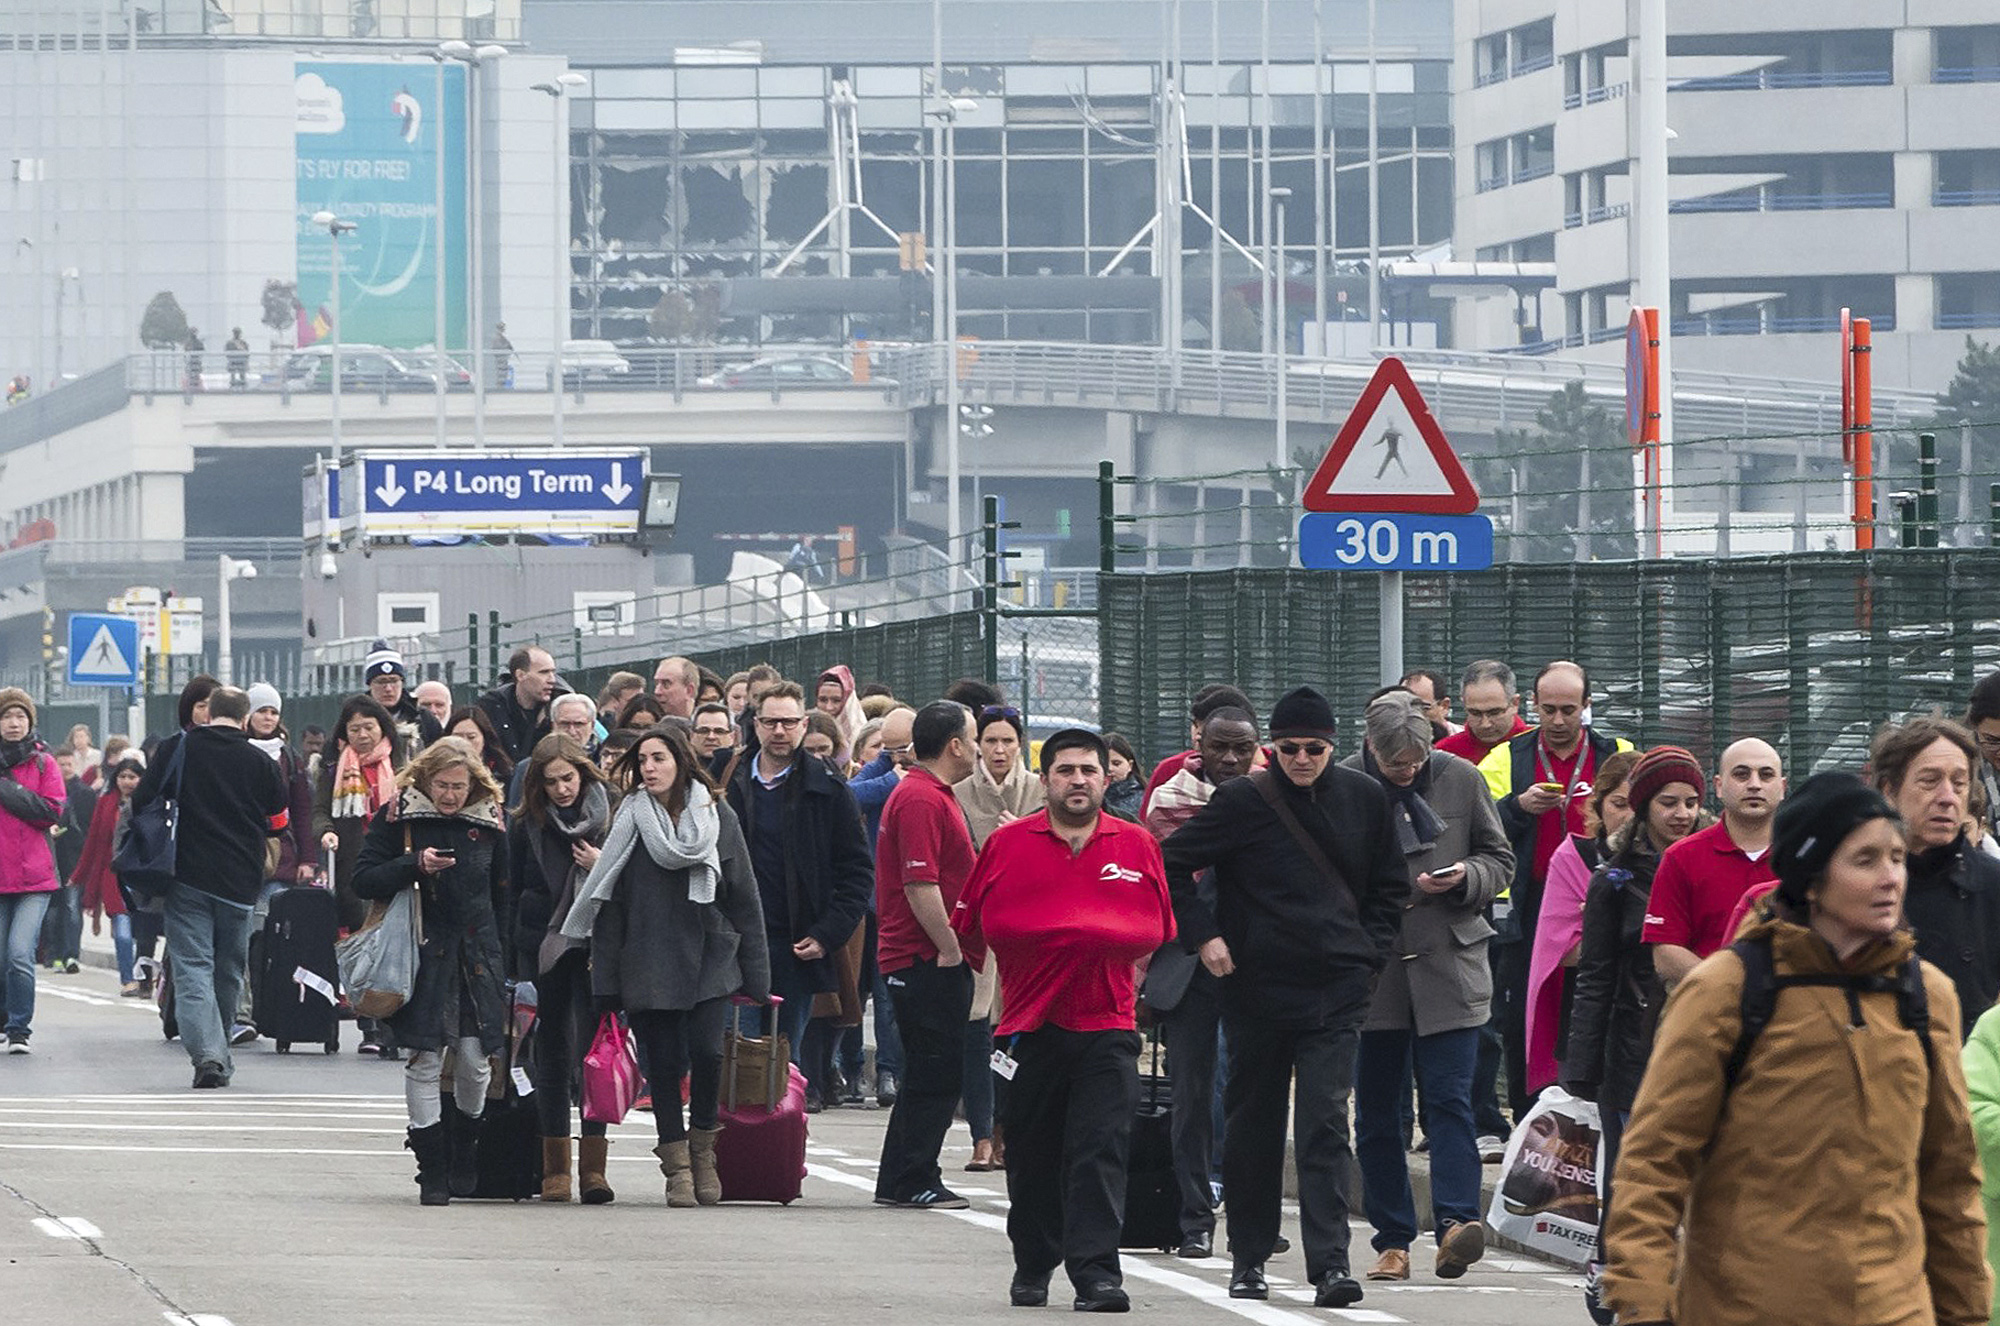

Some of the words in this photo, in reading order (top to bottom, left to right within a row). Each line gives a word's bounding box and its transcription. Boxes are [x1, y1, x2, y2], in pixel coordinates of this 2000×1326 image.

[343, 158, 372, 180] FOR
[413, 470, 448, 494] P4
[455, 470, 521, 499] Long
[528, 469, 593, 493] Term
[1335, 519, 1399, 564] 30
[1412, 531, 1458, 564] m
[1549, 1223, 1571, 1240] TAX
